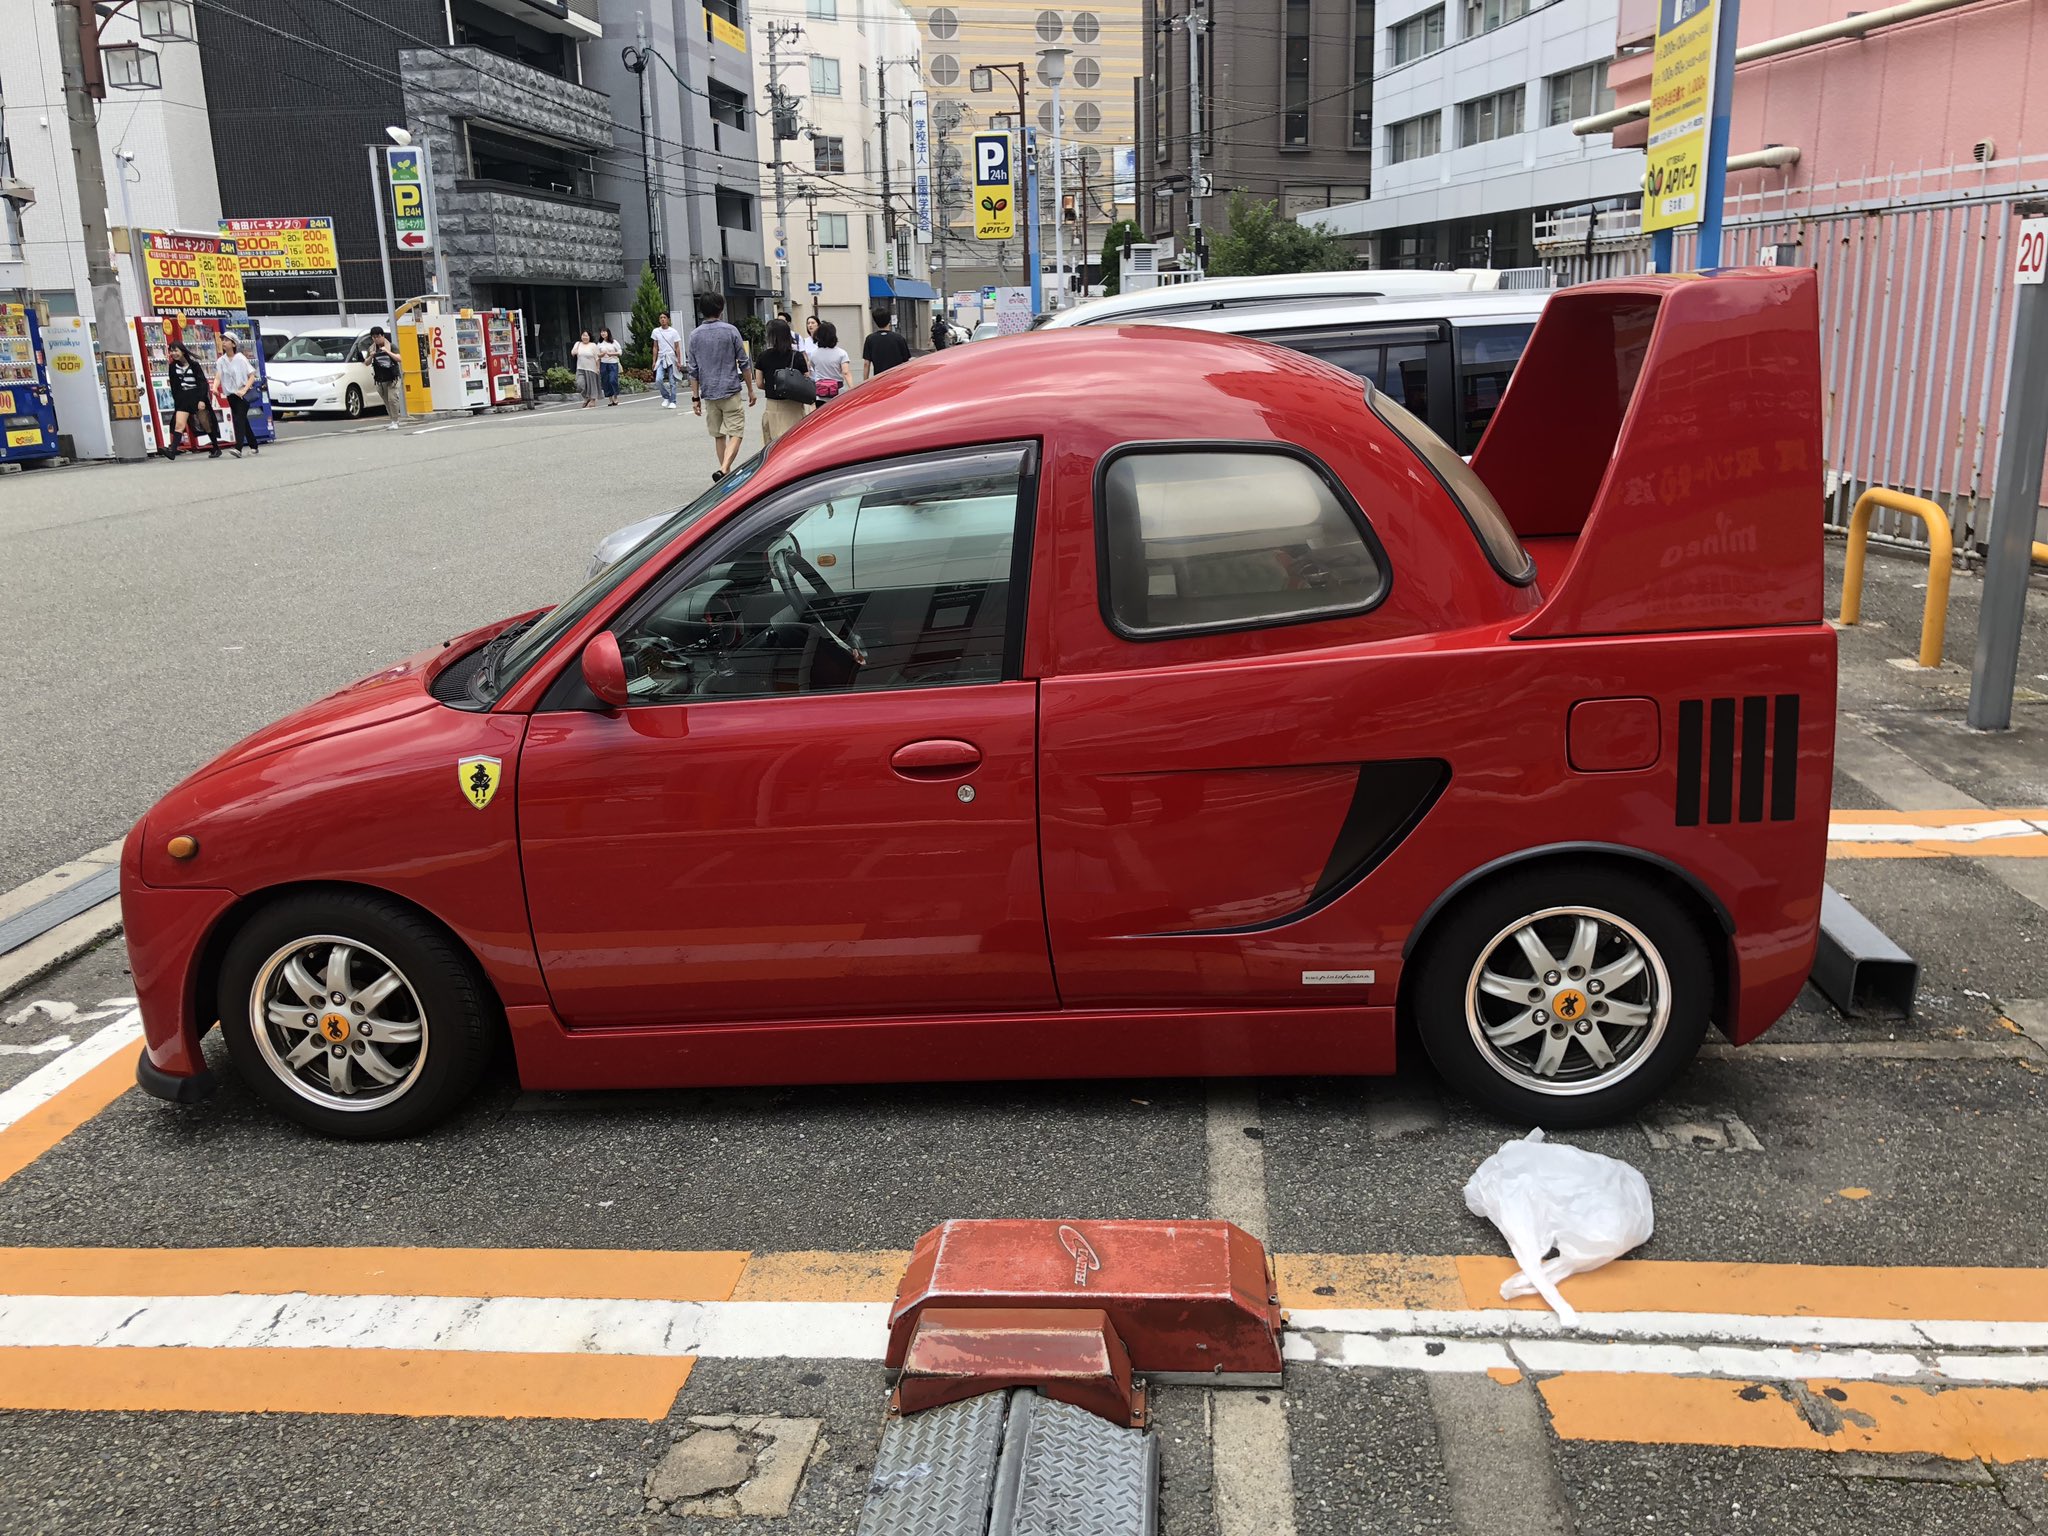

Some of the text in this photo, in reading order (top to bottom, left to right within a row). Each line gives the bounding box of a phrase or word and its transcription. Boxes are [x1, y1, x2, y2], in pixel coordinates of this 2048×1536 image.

[915, 120, 927, 164] 学校法人
[978, 142, 1004, 180] P
[990, 170, 1007, 180] 24h
[1664, 164, 1696, 194] APパーク
[394, 185, 419, 216] P
[405, 208, 421, 216] 24H
[310, 219, 327, 228] 24H
[303, 231, 327, 240] 200円
[221, 242, 234, 253] 24H
[305, 244, 329, 254] 200円
[2018, 232, 2044, 272] 20
[160, 260, 196, 278] 900円
[217, 257, 236, 271] 200円
[308, 257, 331, 267] 100円
[219, 274, 239, 288] 200円
[154, 287, 200, 305] 2200円
[222, 291, 242, 305] 100円
[434, 327, 446, 369] DyDo
[57, 362, 80, 370] 100円
